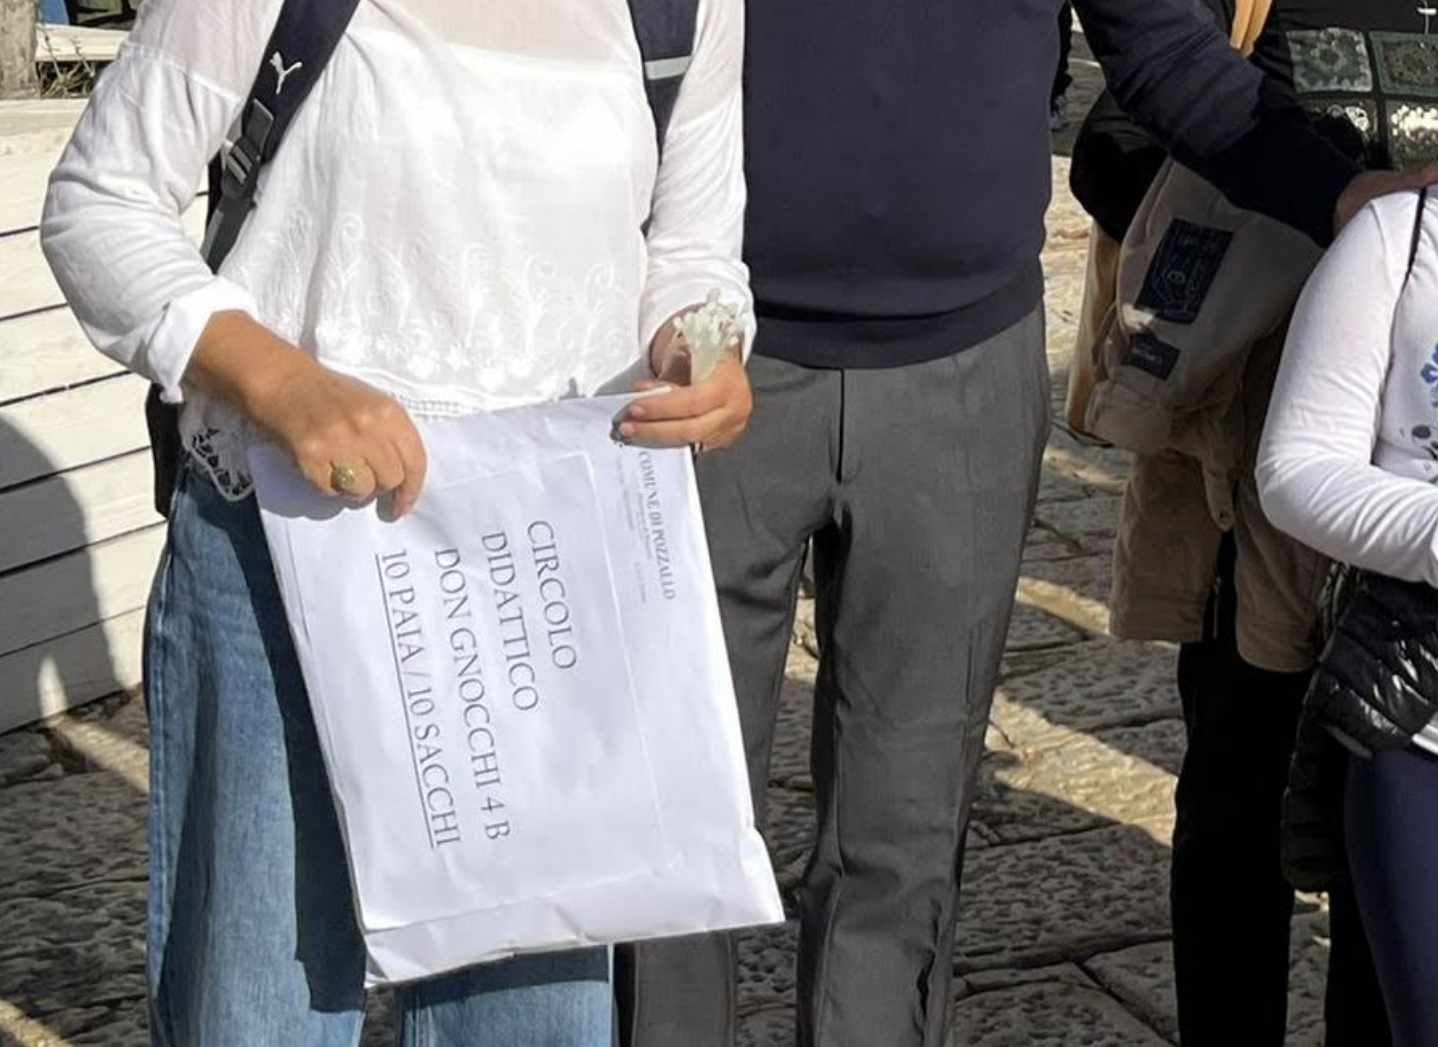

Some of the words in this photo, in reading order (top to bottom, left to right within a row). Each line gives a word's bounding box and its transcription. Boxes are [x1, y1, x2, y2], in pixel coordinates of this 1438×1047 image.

[638, 450, 660, 509] COMUNE
[649, 512, 662, 526] DI
[381, 550, 410, 579] 10
[435, 548, 471, 619] DON
[527, 520, 577, 669] CIRCOLO
[652, 528, 676, 600] POZZALLO
[389, 587, 425, 662] PAIA
[482, 532, 538, 710] DIDATTICO
[408, 687, 434, 716] 10
[450, 628, 500, 788] GNOCCHI
[414, 724, 460, 846] SACCHI
[481, 797, 505, 813] 4
[484, 820, 510, 840] B
